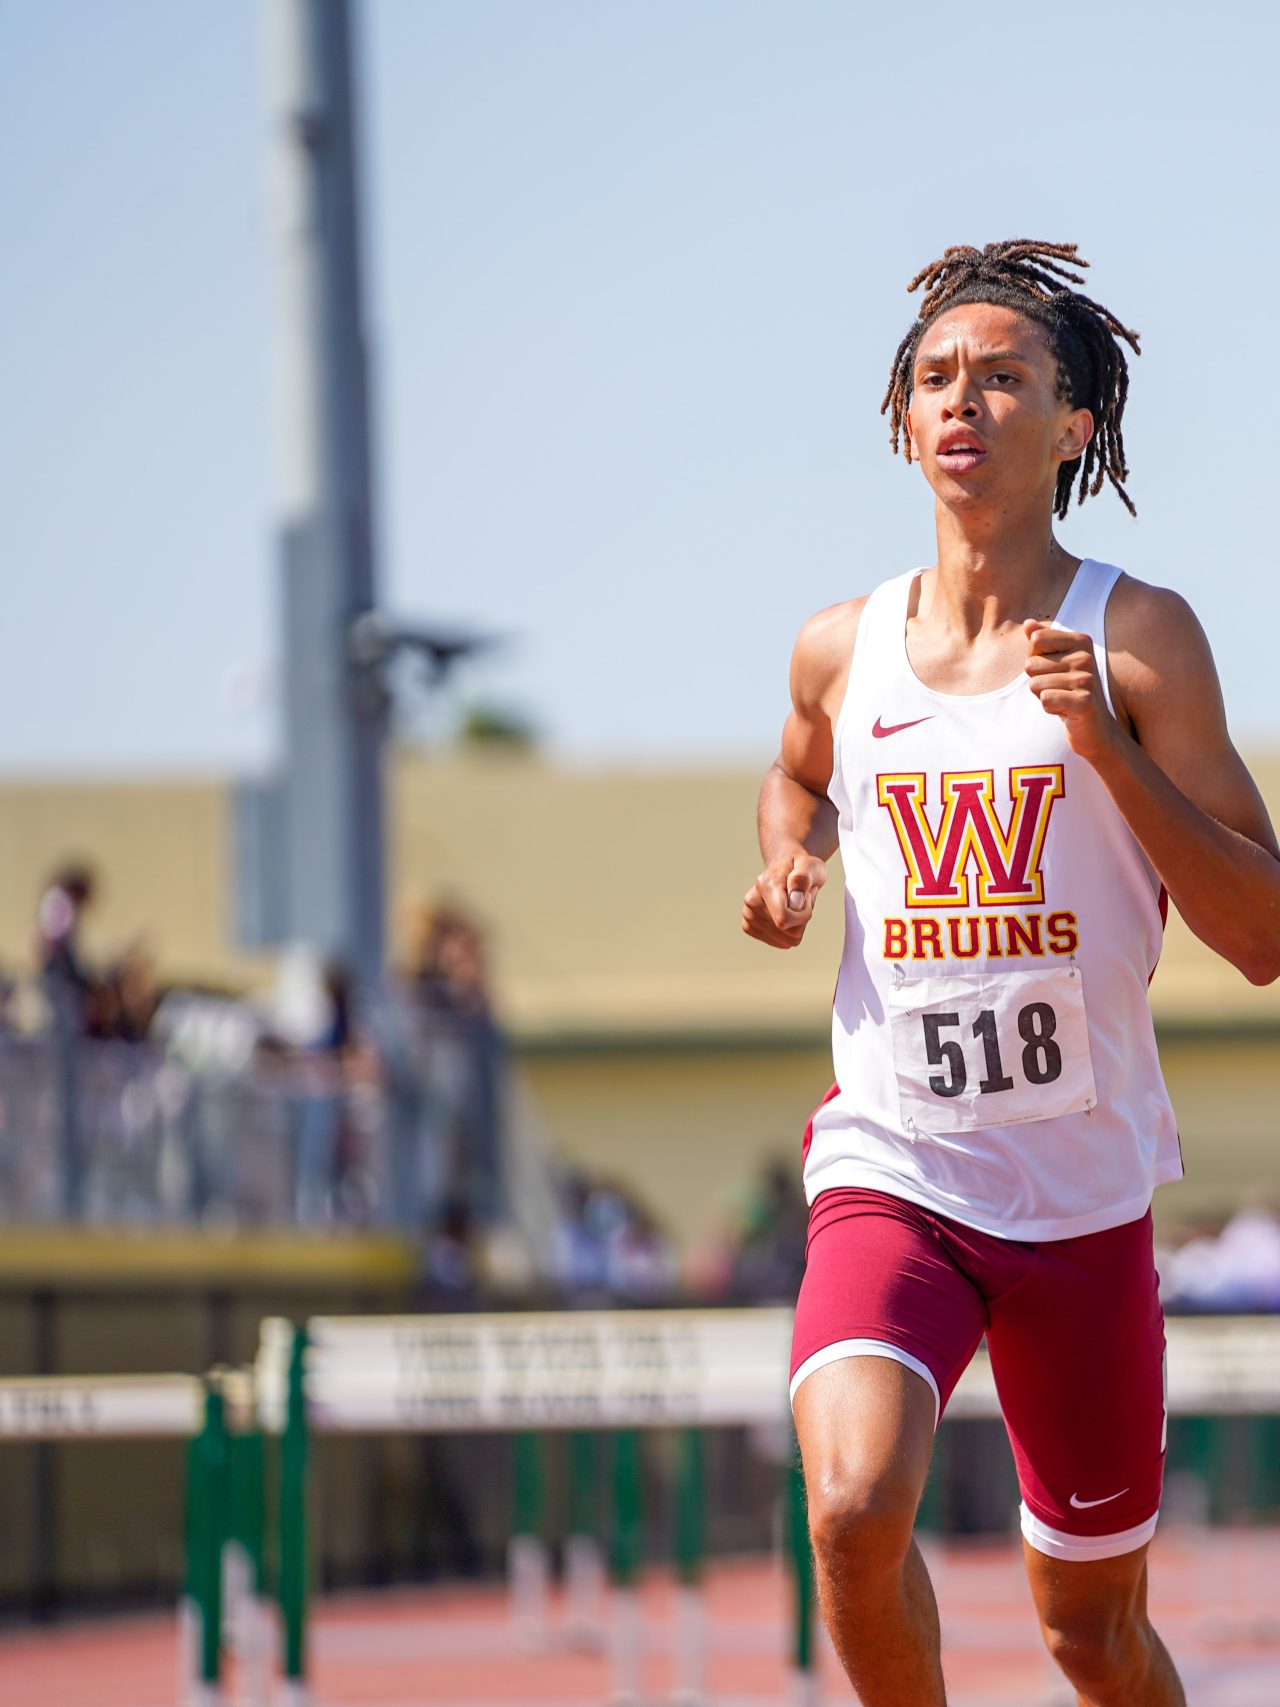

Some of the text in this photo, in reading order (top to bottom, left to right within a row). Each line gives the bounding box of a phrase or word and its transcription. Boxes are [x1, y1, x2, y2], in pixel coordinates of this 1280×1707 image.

[876, 764, 1066, 909] W
[883, 910, 1079, 960] BRUINS
[922, 1002, 1062, 1098] 518
